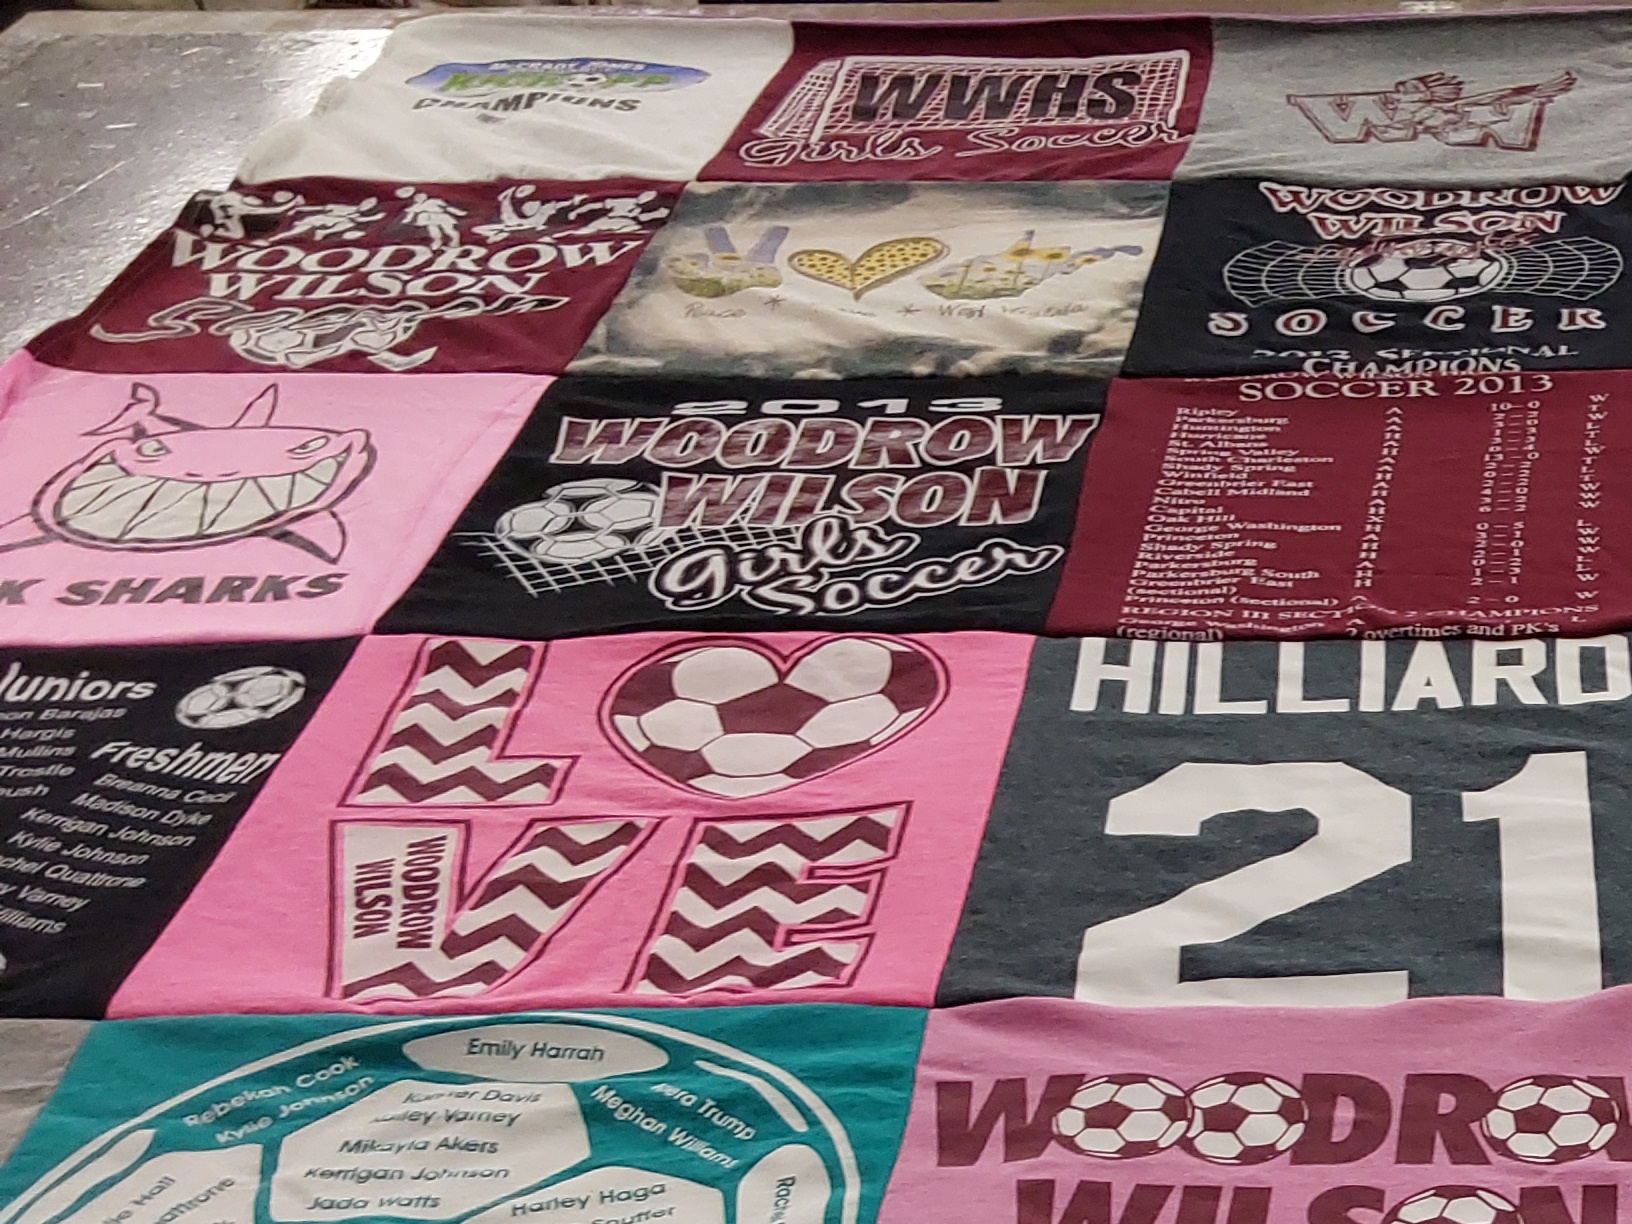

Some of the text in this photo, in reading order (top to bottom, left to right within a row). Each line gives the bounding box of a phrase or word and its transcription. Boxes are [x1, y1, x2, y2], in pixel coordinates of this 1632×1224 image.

[852, 71, 1142, 121] WWHS
[738, 120, 1193, 167] Girls Soccer
[1259, 182, 1625, 214] WOODROW
[1309, 210, 1567, 240] WILSON
[171, 229, 645, 272] WOODROW
[208, 270, 547, 301] WILSON
[1206, 304, 1608, 337] SOCCER
[1302, 357, 1522, 377] CHAMPIONS
[1239, 374, 1554, 400] SOCCER 2013
[671, 397, 1004, 415] 2013
[1176, 406, 1239, 418] Ripley
[549, 414, 1102, 468] WOODROW
[658, 466, 1049, 527] WILSON
[1153, 496, 1207, 506] Nitro
[1154, 487, 1312, 498] Cabell Midland
[1147, 514, 1190, 524] Oak
[1149, 504, 1224, 515] Capital
[1142, 532, 1241, 542] Princeton
[1144, 522, 1342, 534] George Washington
[650, 513, 922, 611] Girls
[743, 536, 1065, 615] Soccer
[55, 572, 350, 606] SHARKS
[1364, 621, 1560, 641] overtimes and PK's
[90, 740, 282, 784] Freshmen
[92, 773, 183, 802] Breanna
[70, 792, 214, 828] Madison Dyke
[20, 807, 197, 848] Kerrigan Johnson
[6, 830, 150, 866] Kylie Johnson
[396, 833, 448, 950] WOODROW
[1074, 750, 1603, 1007] 21
[353, 857, 397, 940] WILSON
[466, 1037, 605, 1062] Emily Harrah
[181, 1054, 362, 1129] Rebekah Cook
[589, 1084, 668, 1136] Meghan
[696, 1098, 758, 1141] Trump
[434, 1135, 501, 1154] Akers
[306, 1195, 373, 1212] Jada
[599, 1183, 668, 1206] Haga
